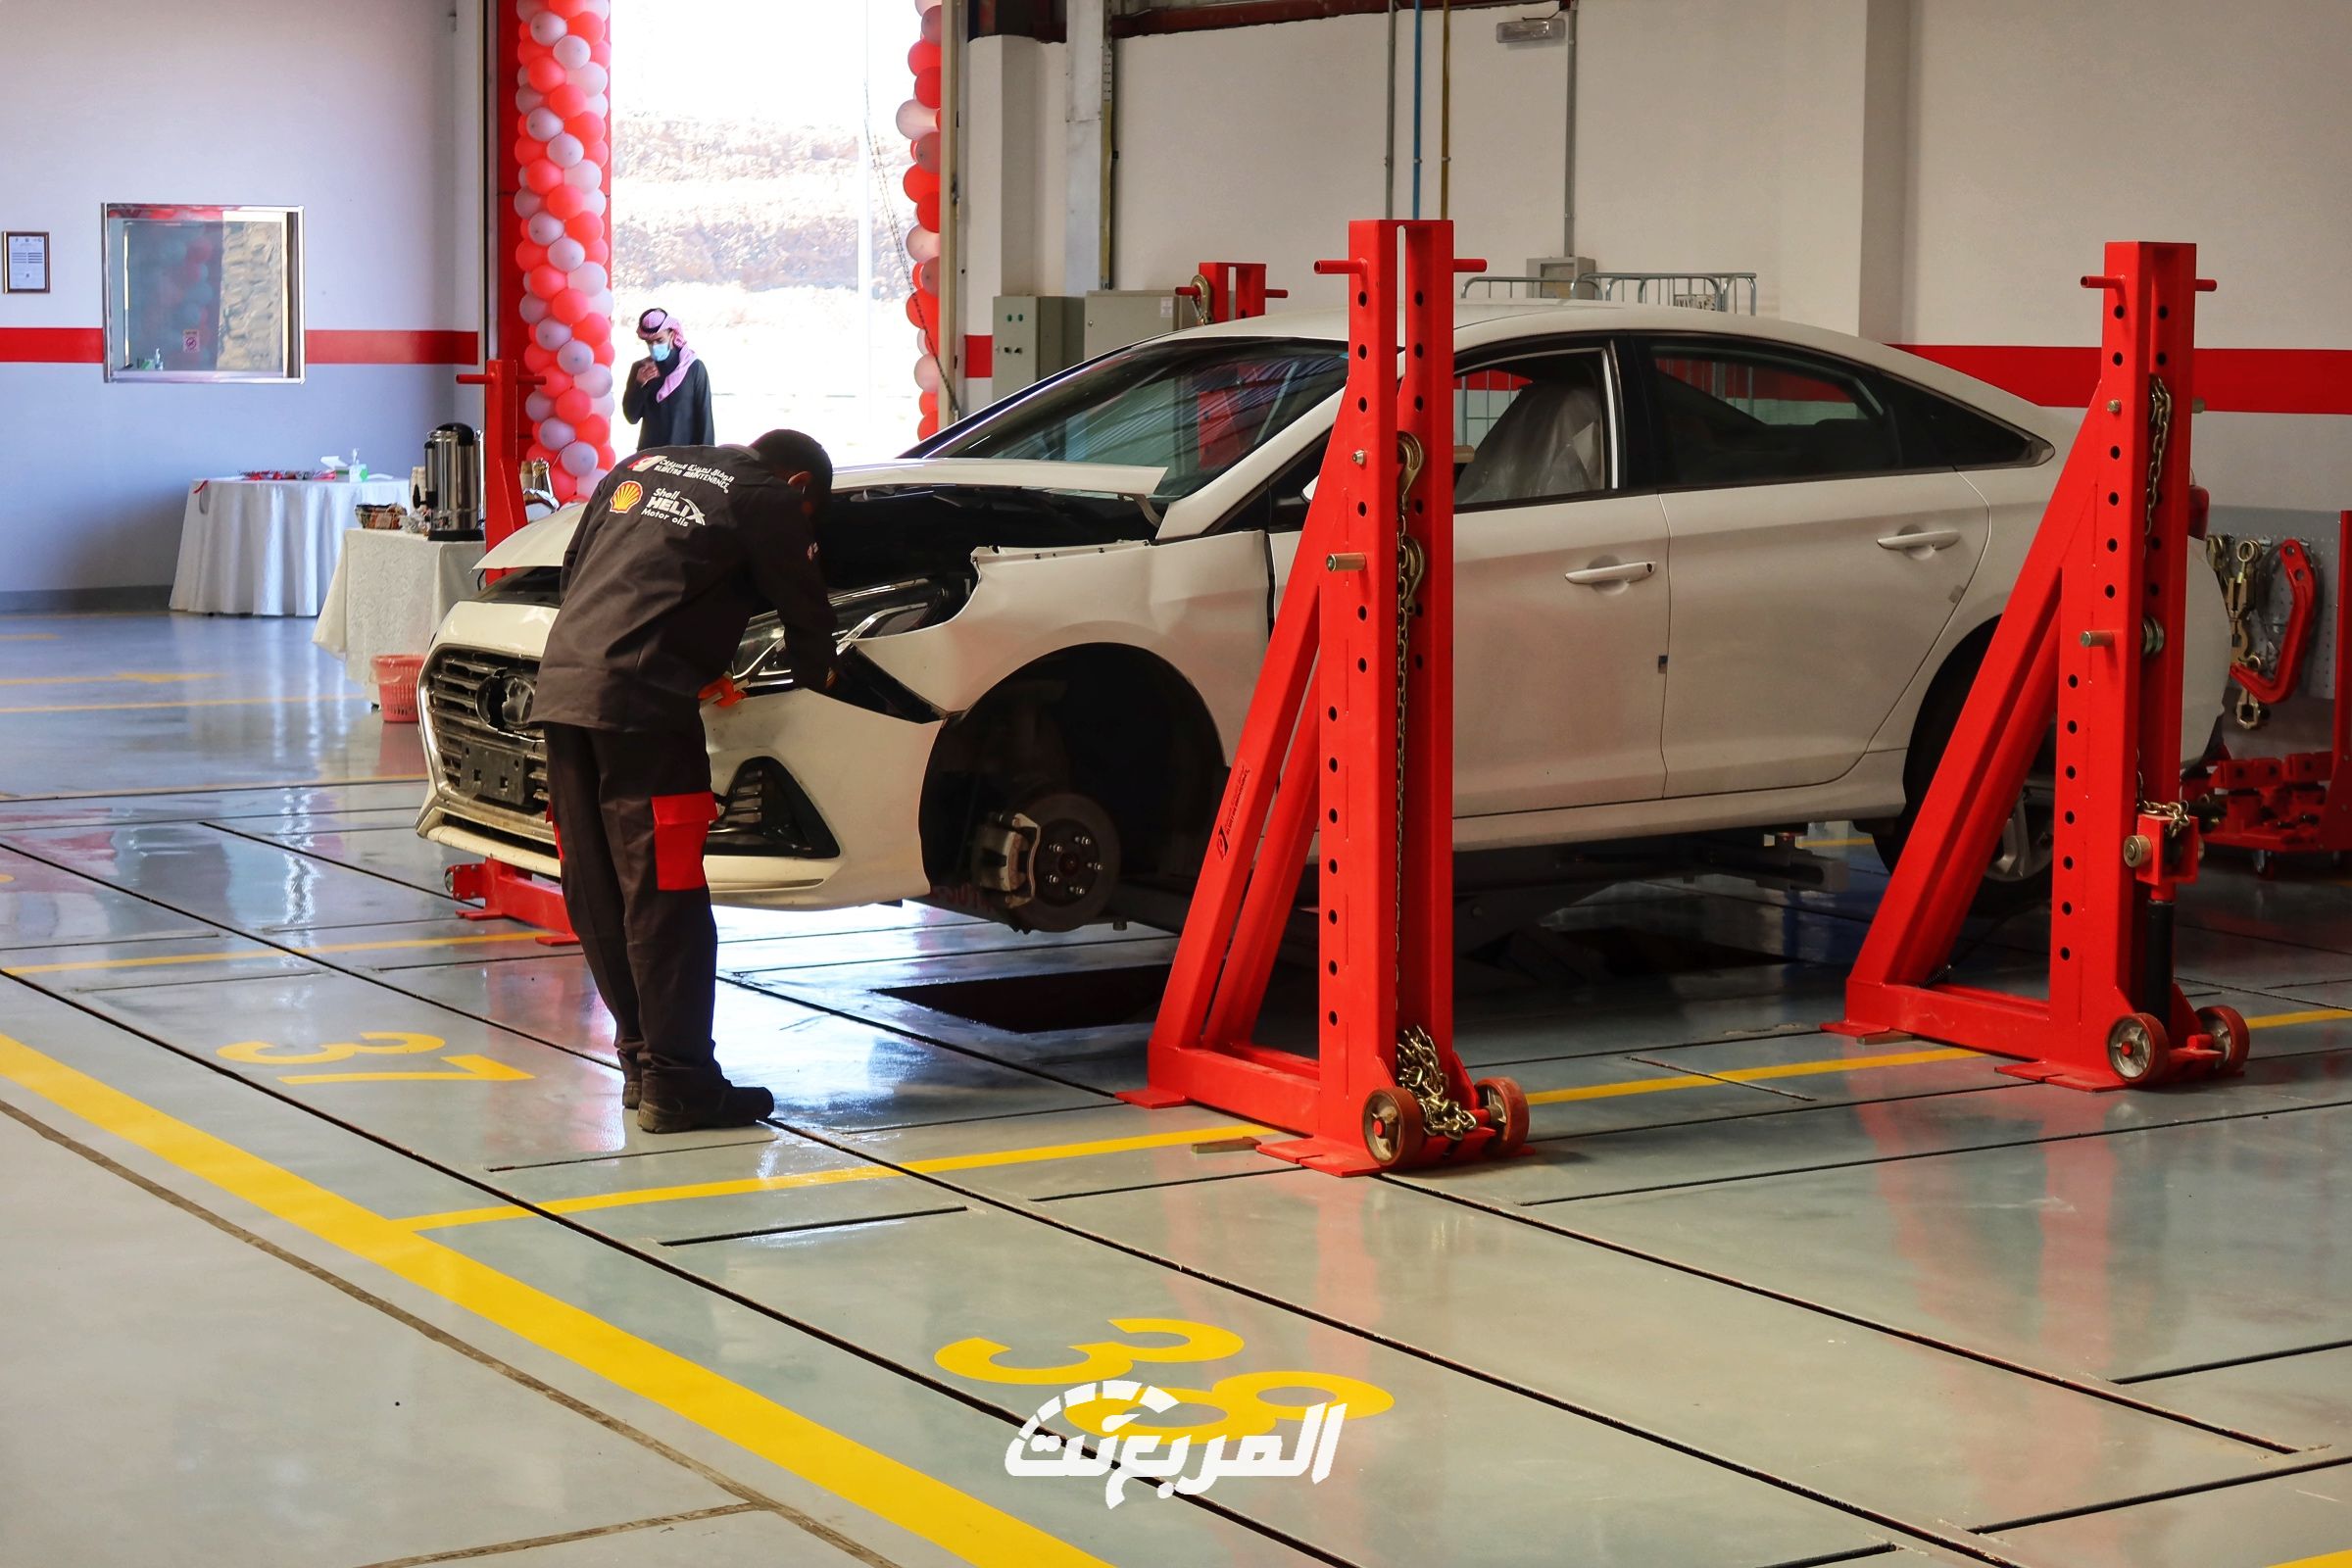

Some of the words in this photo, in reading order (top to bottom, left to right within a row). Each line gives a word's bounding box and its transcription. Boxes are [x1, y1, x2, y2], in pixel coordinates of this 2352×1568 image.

[682, 470, 730, 489] MAINTENANCE
[653, 488, 681, 500] Shell
[641, 508, 670, 520] Motor
[671, 517, 690, 527] oils
[646, 496, 706, 525] HELIX
[934, 1317, 1396, 1446] 38
